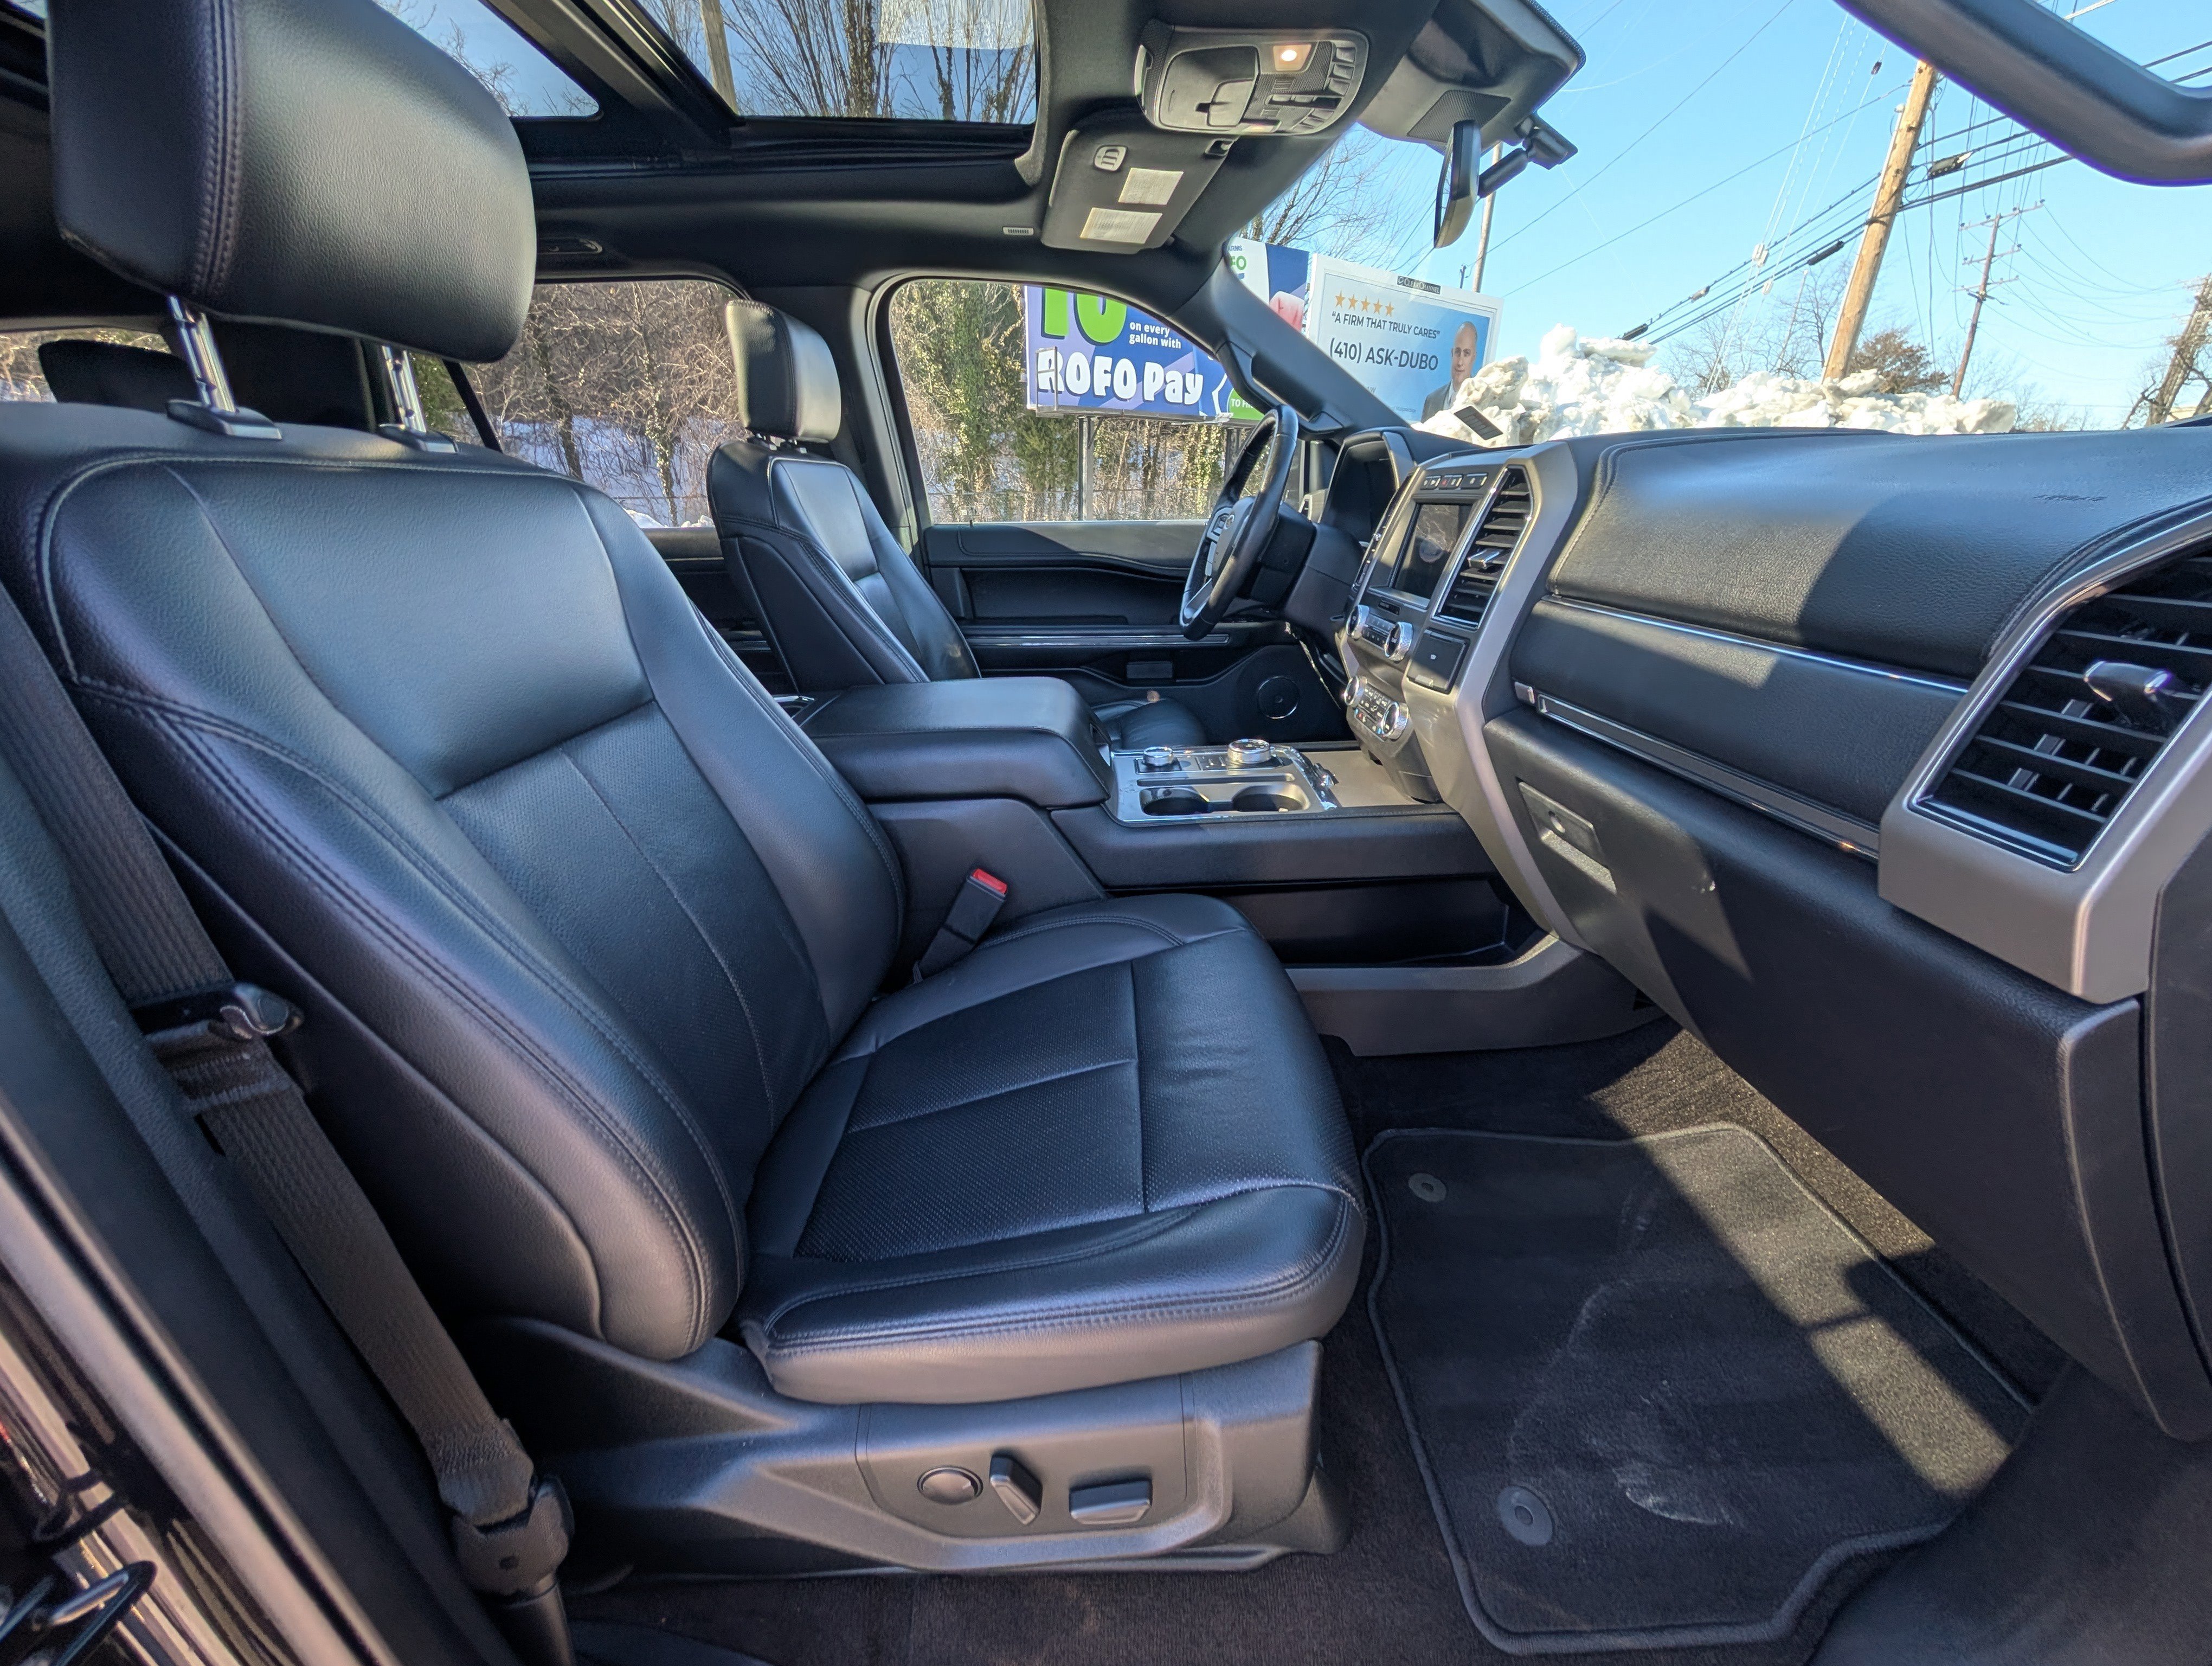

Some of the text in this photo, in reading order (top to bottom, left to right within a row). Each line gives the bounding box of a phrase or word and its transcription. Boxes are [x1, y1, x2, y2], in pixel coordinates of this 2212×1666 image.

[1129, 322, 1170, 337] on every
[1343, 313, 1365, 325] FIRM
[1366, 317, 1387, 329] THAT
[1388, 321, 1412, 334] TRULY
[1129, 333, 1182, 349] gallon with
[1330, 337, 1439, 371] (410) ASK-DUBO
[1037, 350, 1204, 405] ROFO Pay
[1231, 398, 1241, 407] TO
